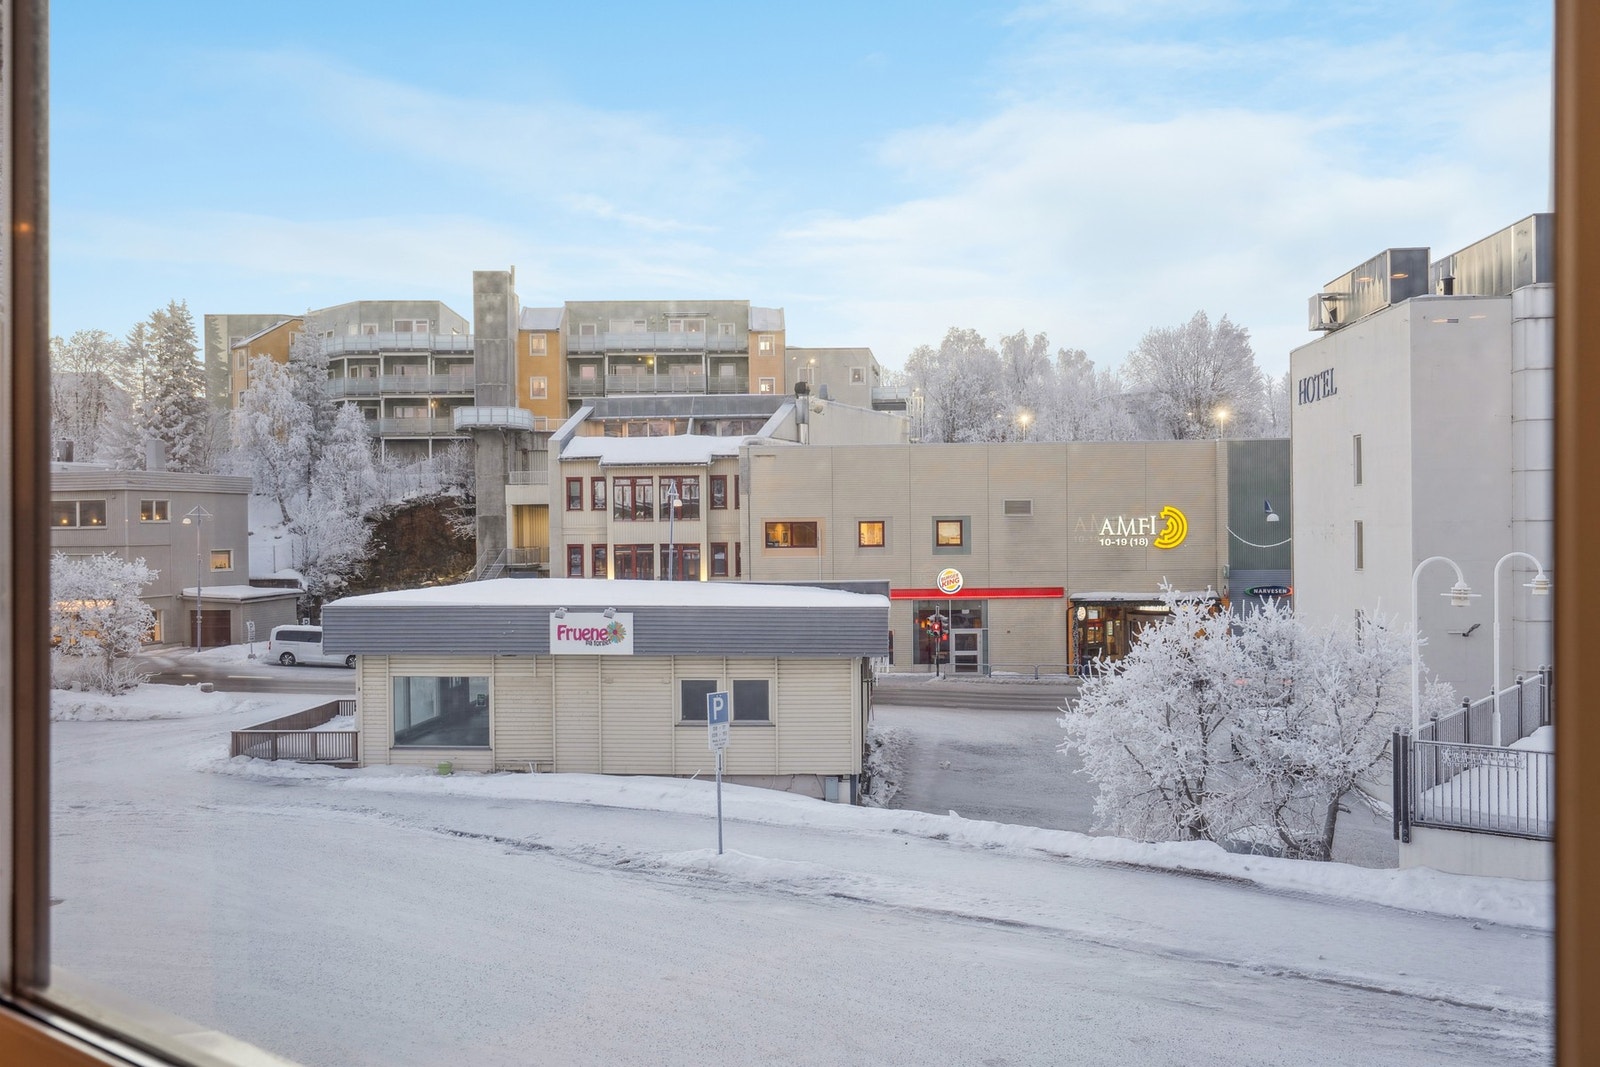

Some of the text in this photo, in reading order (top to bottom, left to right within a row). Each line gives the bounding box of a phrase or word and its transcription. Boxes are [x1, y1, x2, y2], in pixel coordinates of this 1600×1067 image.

[1298, 367, 1338, 406] HOTEL
[1099, 515, 1157, 537] AMFI
[1100, 538, 1149, 547] 10-19 (18)
[942, 578, 960, 587] KING
[556, 624, 609, 641] Fruene
[713, 696, 724, 721] P
